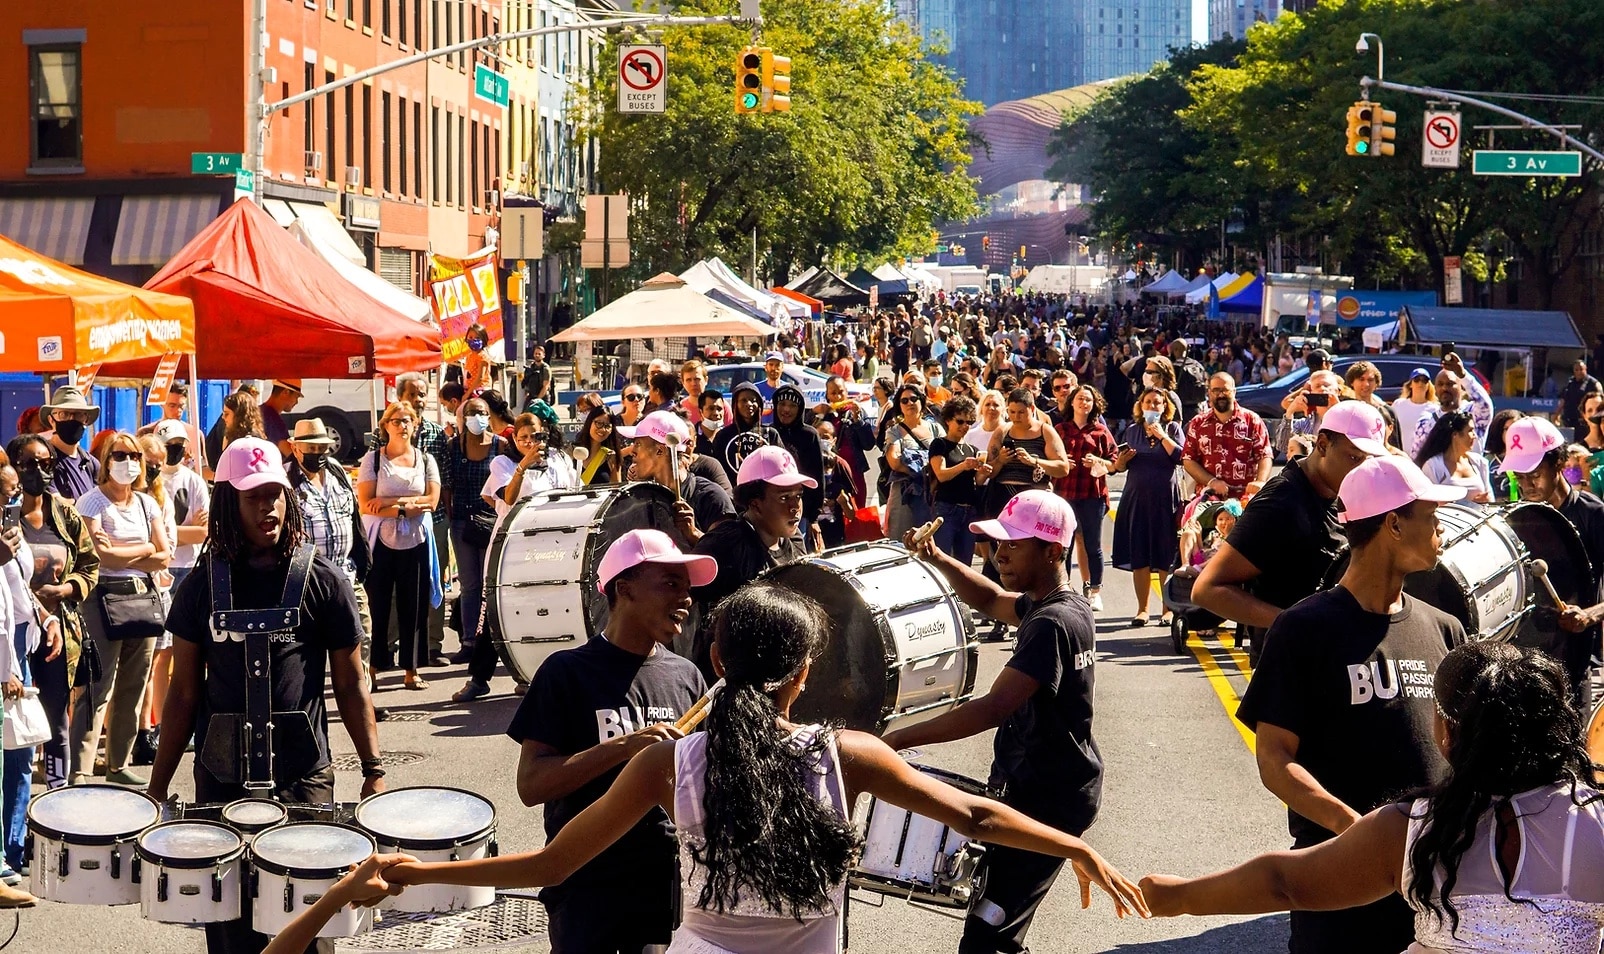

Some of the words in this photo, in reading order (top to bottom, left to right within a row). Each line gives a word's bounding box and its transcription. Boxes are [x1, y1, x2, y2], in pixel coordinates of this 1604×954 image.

[627, 93, 657, 101] EXCEPT
[628, 102, 655, 110] BUSES
[206, 155, 214, 171] 3
[219, 156, 230, 166] Av
[1507, 156, 1517, 169] 3
[1526, 157, 1547, 170] Av
[89, 311, 148, 355] empowering
[146, 319, 182, 340] women
[1531, 399, 1554, 407] POLICE
[904, 619, 946, 641] Dynasty
[267, 633, 296, 643] RPOSE
[1398, 660, 1427, 672] PRIDE
[1346, 659, 1399, 705] BU
[1401, 673, 1435, 686] PASSIO
[647, 706, 675, 719] PRIDE
